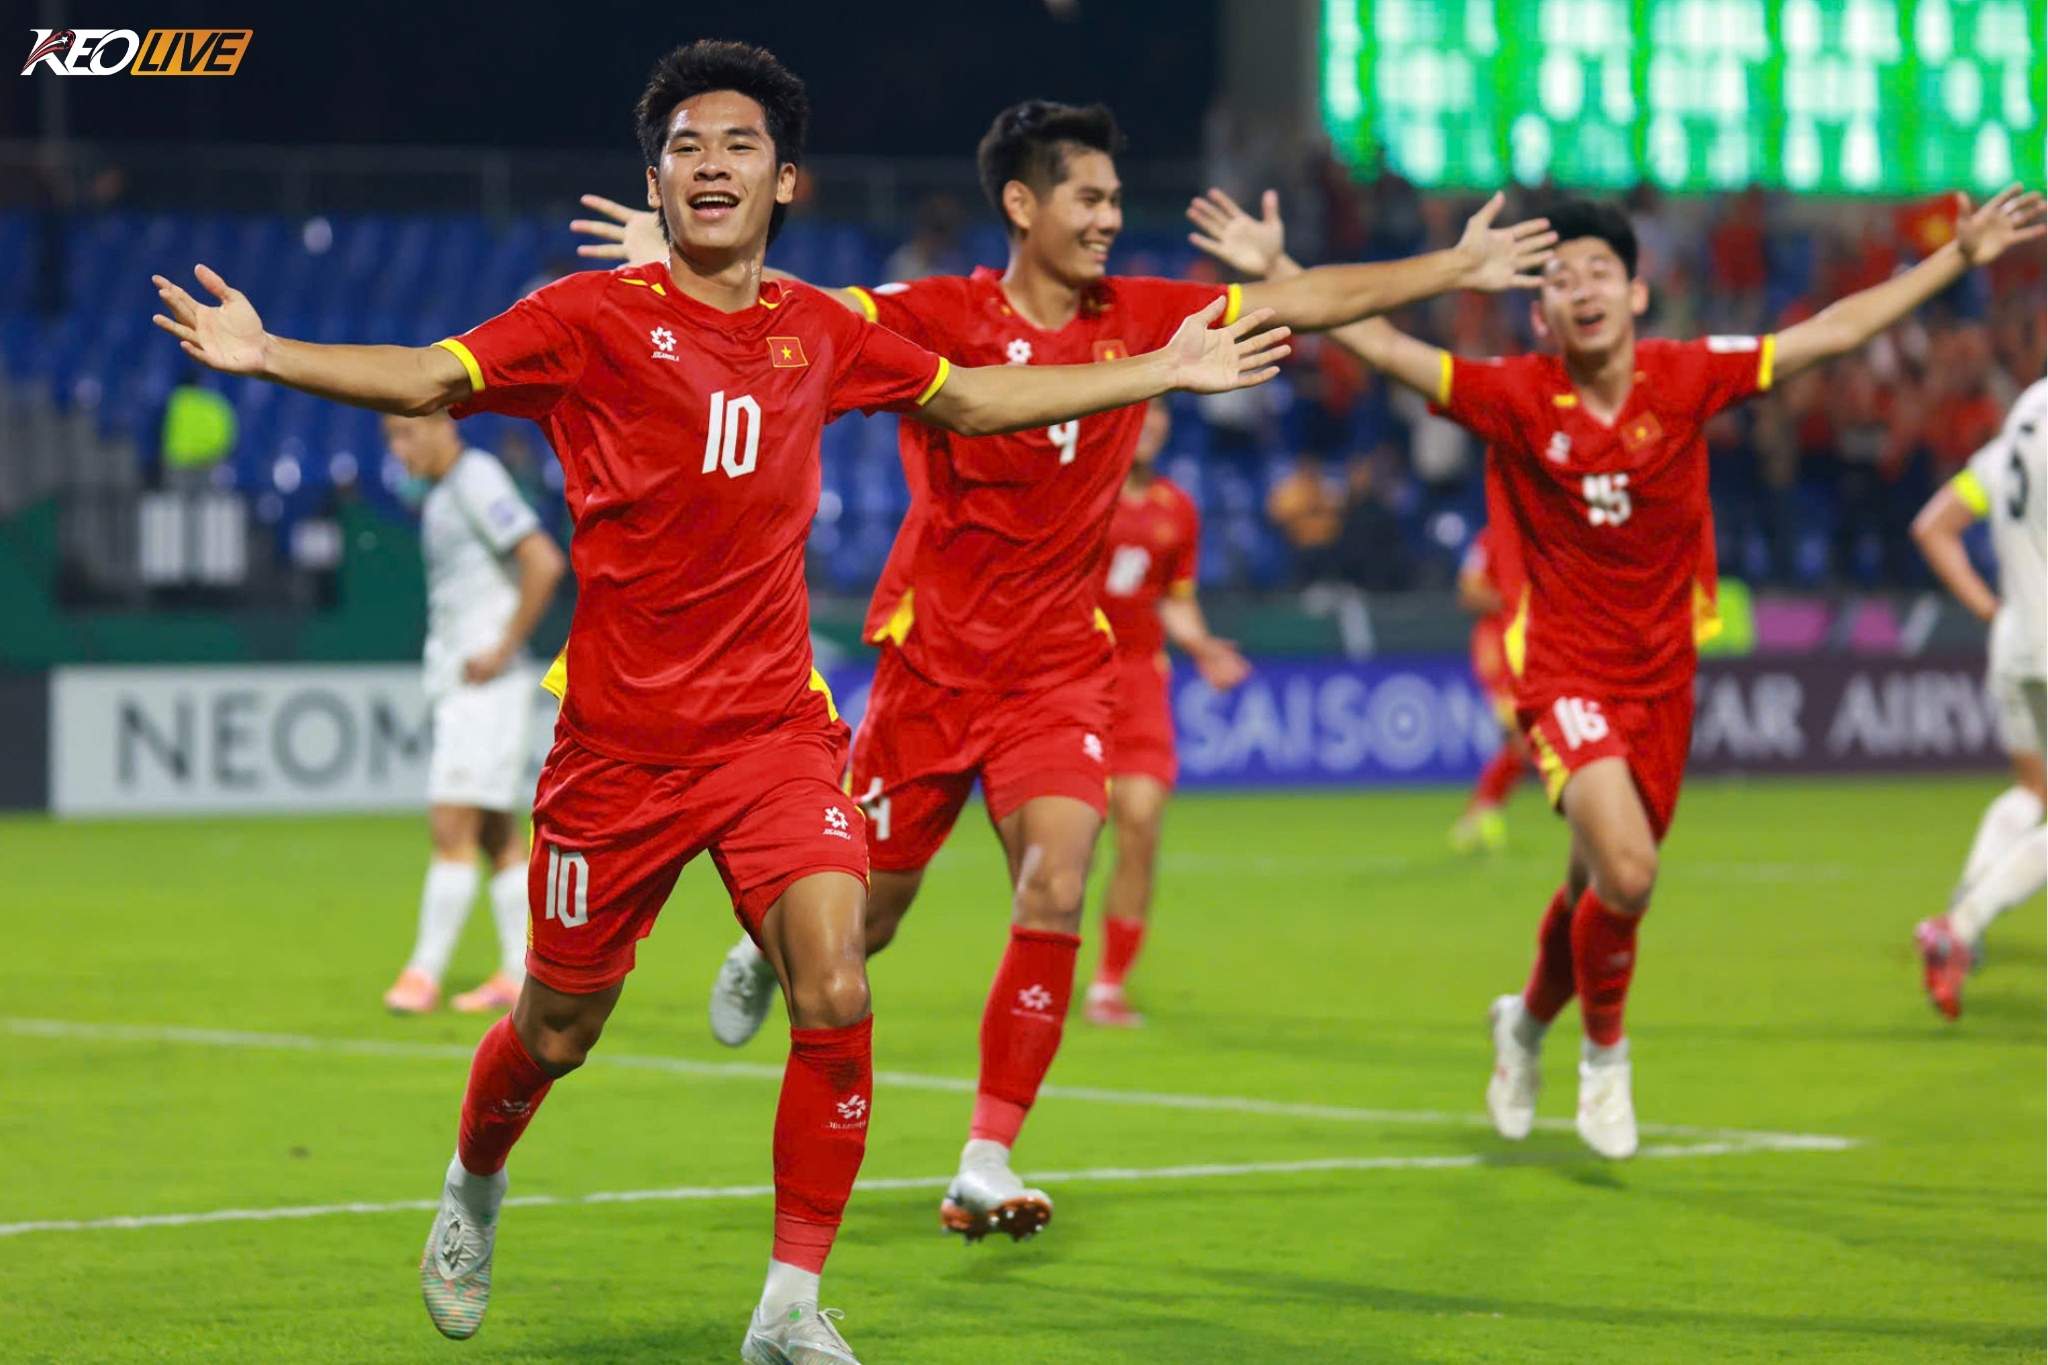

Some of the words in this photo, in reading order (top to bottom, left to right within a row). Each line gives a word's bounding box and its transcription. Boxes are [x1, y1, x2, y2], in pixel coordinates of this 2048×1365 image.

[701, 390, 761, 479] 10
[116, 688, 434, 788] NEOM
[1179, 673, 1500, 774] SAISON
[1553, 695, 1610, 751] 16
[545, 844, 590, 929] 10
